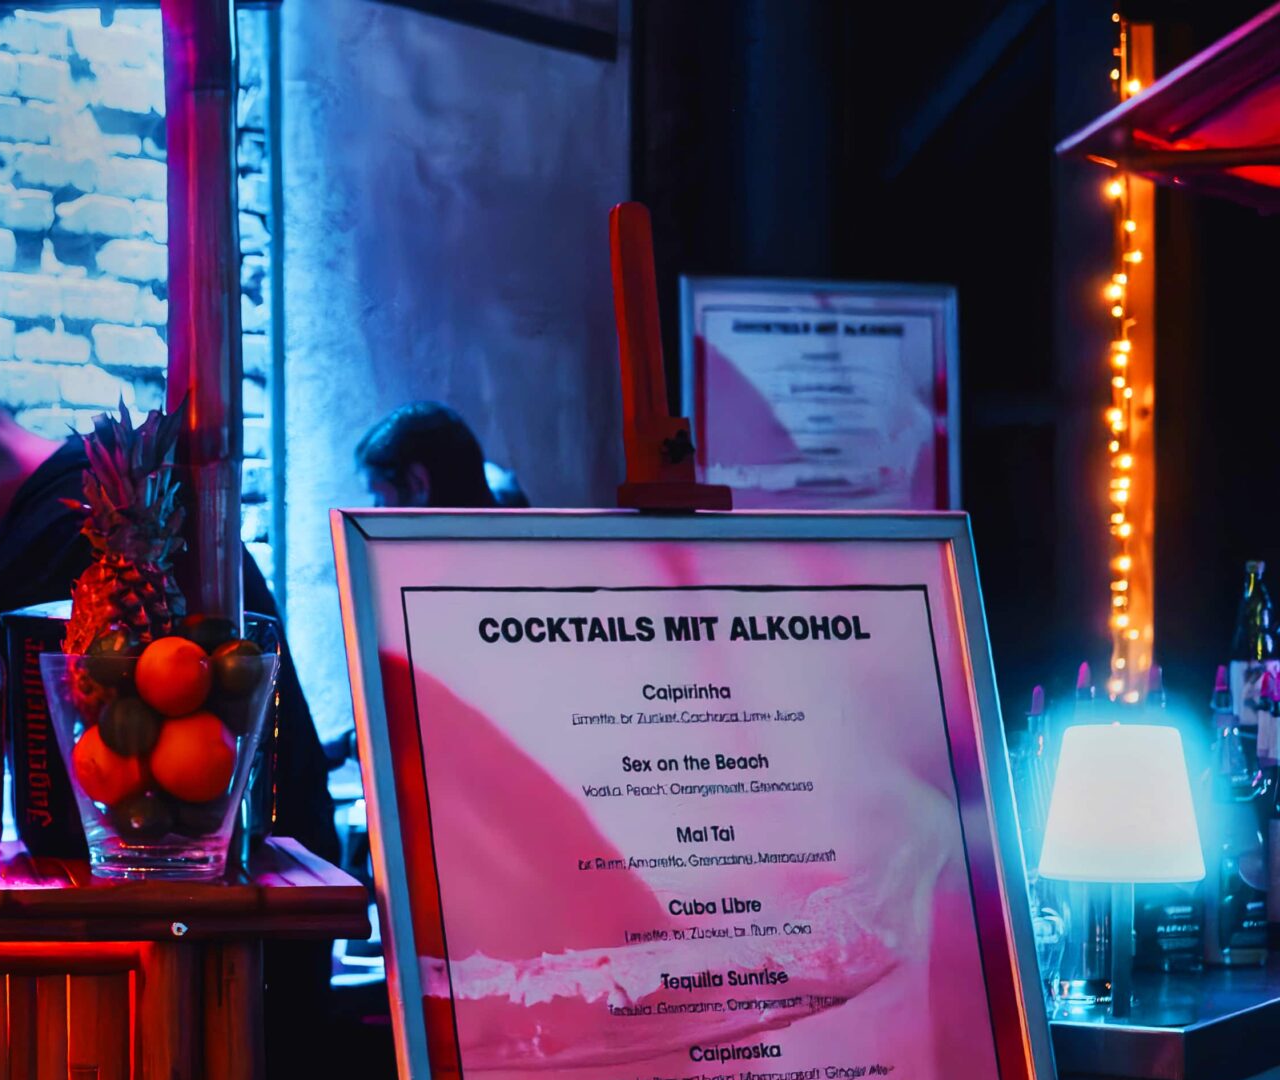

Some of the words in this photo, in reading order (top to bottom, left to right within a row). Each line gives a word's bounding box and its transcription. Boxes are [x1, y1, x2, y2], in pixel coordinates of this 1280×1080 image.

[478, 616, 656, 643] COCKTAILS
[664, 615, 719, 643] MIT
[730, 614, 871, 642] ALKOHOL
[642, 683, 732, 703] Caipirinha
[622, 755, 652, 772] Sex
[657, 758, 679, 771] on
[683, 755, 710, 771] the
[715, 753, 769, 770] Beach
[676, 826, 708, 843] Mai
[710, 825, 735, 842] Tai
[668, 899, 717, 916] Cuba
[722, 897, 761, 915] Libre
[660, 970, 723, 992] Tequila
[728, 968, 789, 986] Sunrise
[689, 1042, 781, 1064] Caipiroska
